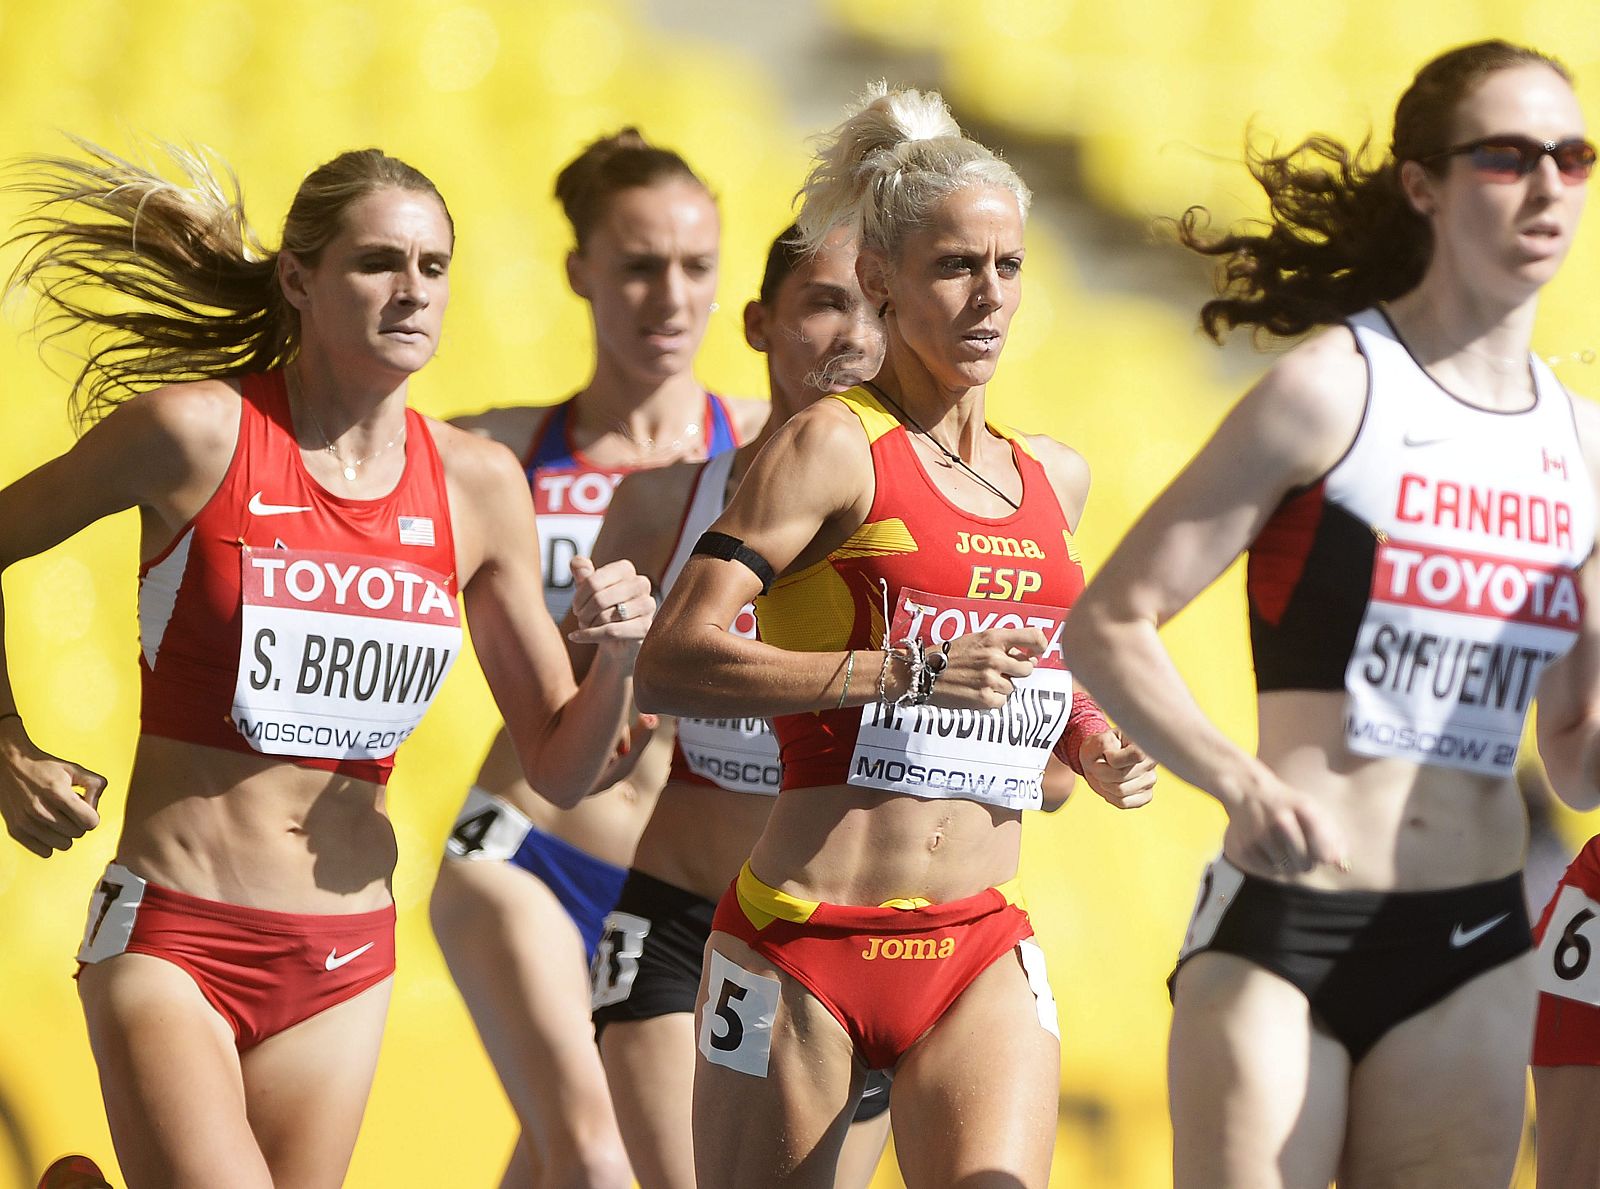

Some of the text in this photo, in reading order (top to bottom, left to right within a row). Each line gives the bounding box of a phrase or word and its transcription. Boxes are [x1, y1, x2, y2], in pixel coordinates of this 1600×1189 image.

[1396, 475, 1574, 551] CANADA
[252, 557, 456, 618] TOYOTA
[967, 566, 1043, 602] ESP
[1383, 551, 1580, 623] TOYOTA
[249, 628, 450, 704] S. BROWN
[1364, 624, 1556, 712] SIFUENT
[239, 718, 361, 748] MOSCOW
[1345, 717, 1488, 761] MOSCOW
[856, 756, 1040, 800] MOSCOW 2013
[454, 809, 500, 857] 4
[1553, 908, 1597, 980] 6
[710, 977, 748, 1051] 5
